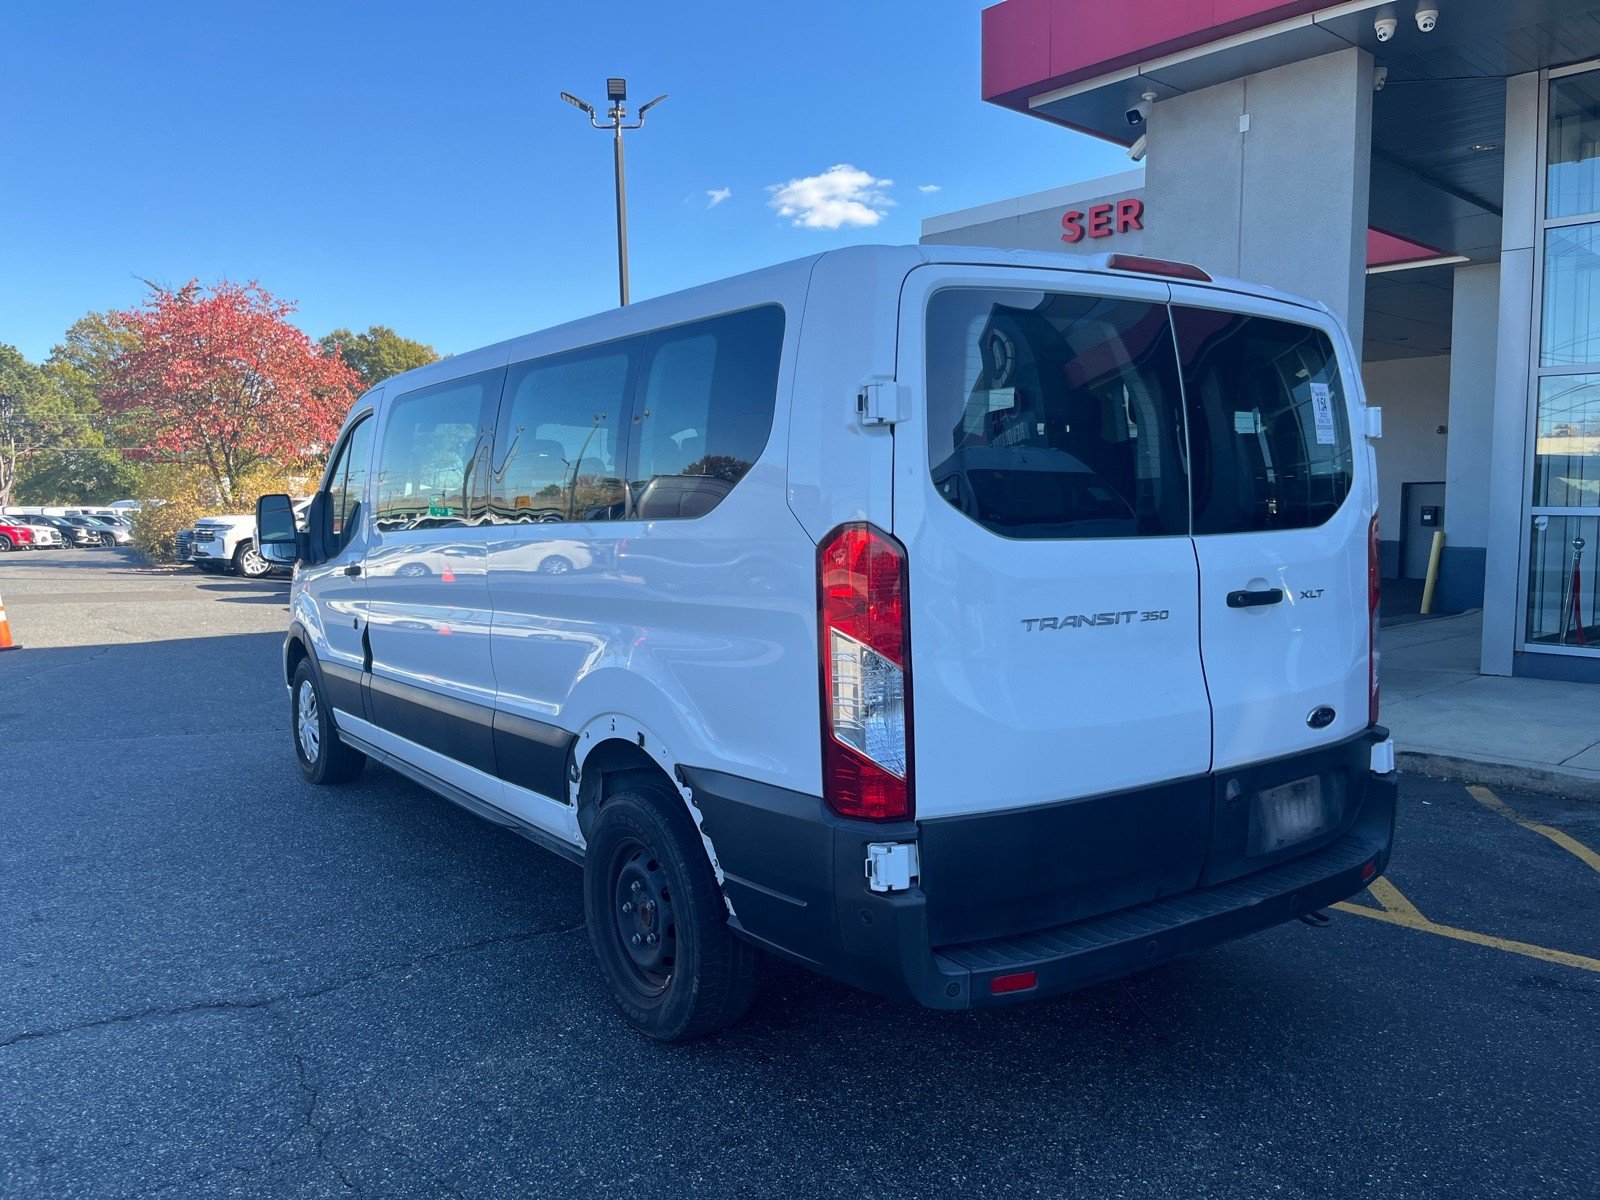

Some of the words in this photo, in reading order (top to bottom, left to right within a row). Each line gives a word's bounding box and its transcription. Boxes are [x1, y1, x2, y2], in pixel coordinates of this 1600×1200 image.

[1061, 198, 1144, 243] SER
[1299, 588, 1325, 600] XLT
[1020, 610, 1138, 632] TRANSIT
[1140, 609, 1170, 622] 350
